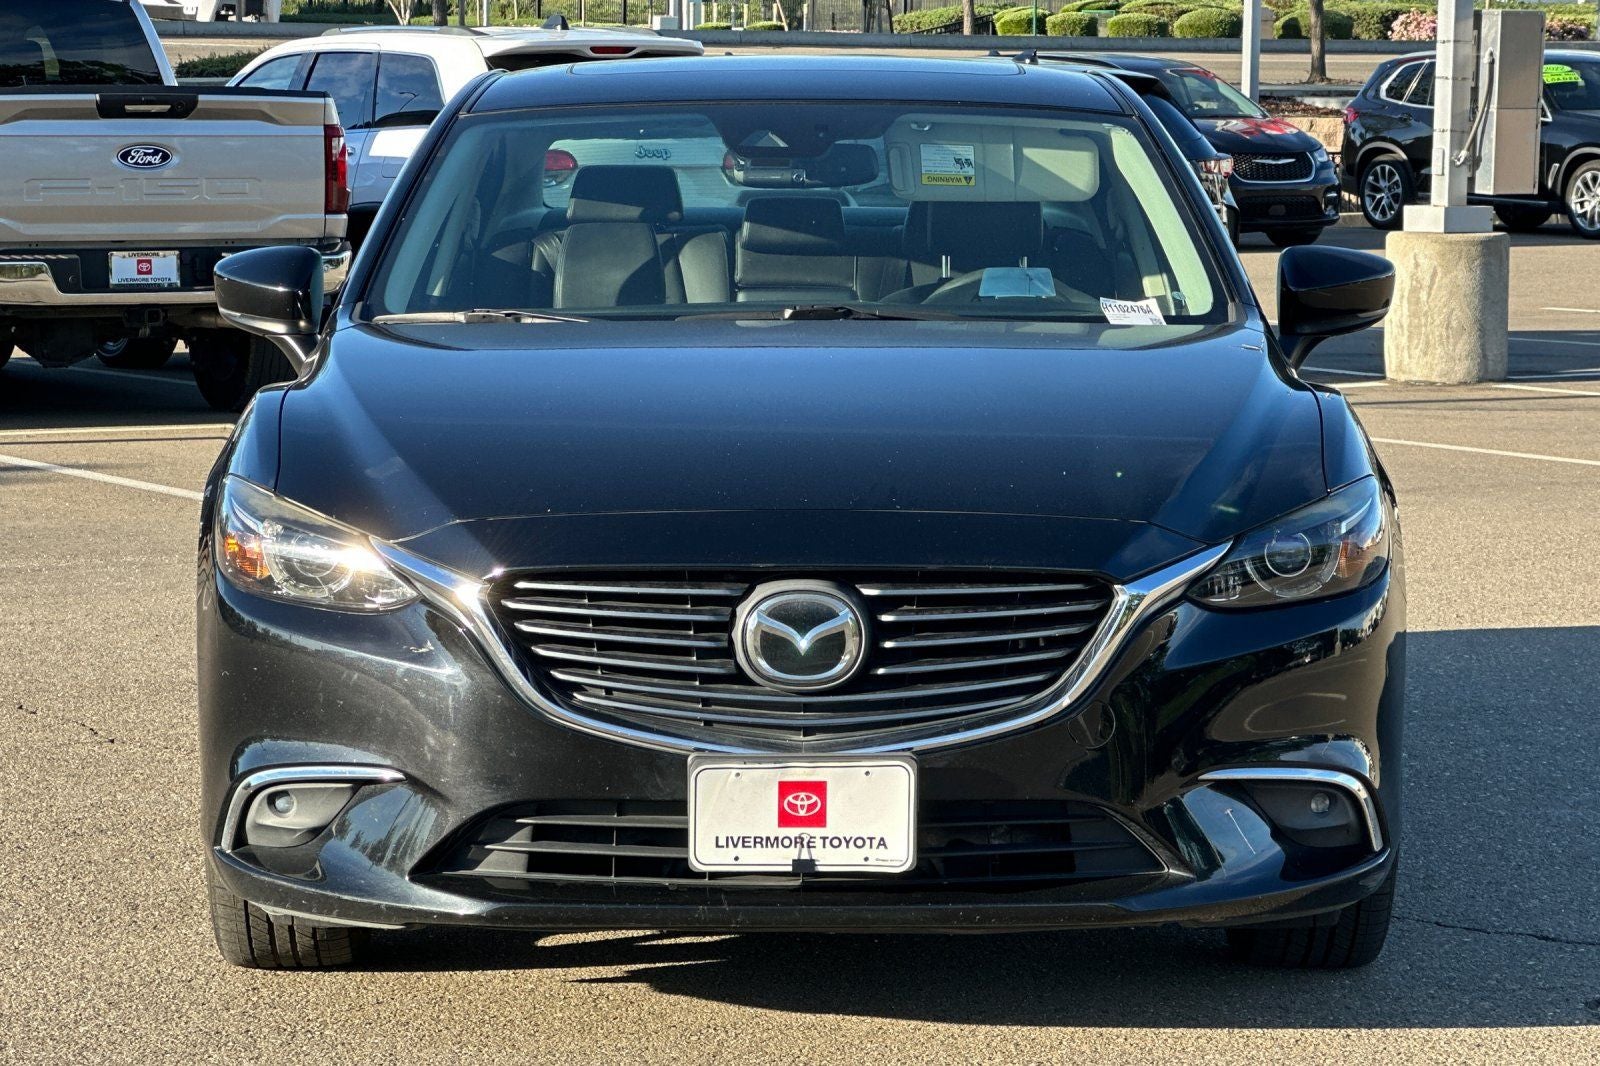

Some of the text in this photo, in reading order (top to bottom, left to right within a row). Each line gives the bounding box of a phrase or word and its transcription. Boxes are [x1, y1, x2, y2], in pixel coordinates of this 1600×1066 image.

[127, 149, 163, 165] Ford
[635, 145, 671, 160] Jeep
[24, 178, 261, 200] F-150
[1102, 302, 1153, 314] H1102476A
[715, 835, 888, 850] LIVERMORE TOYOTA
